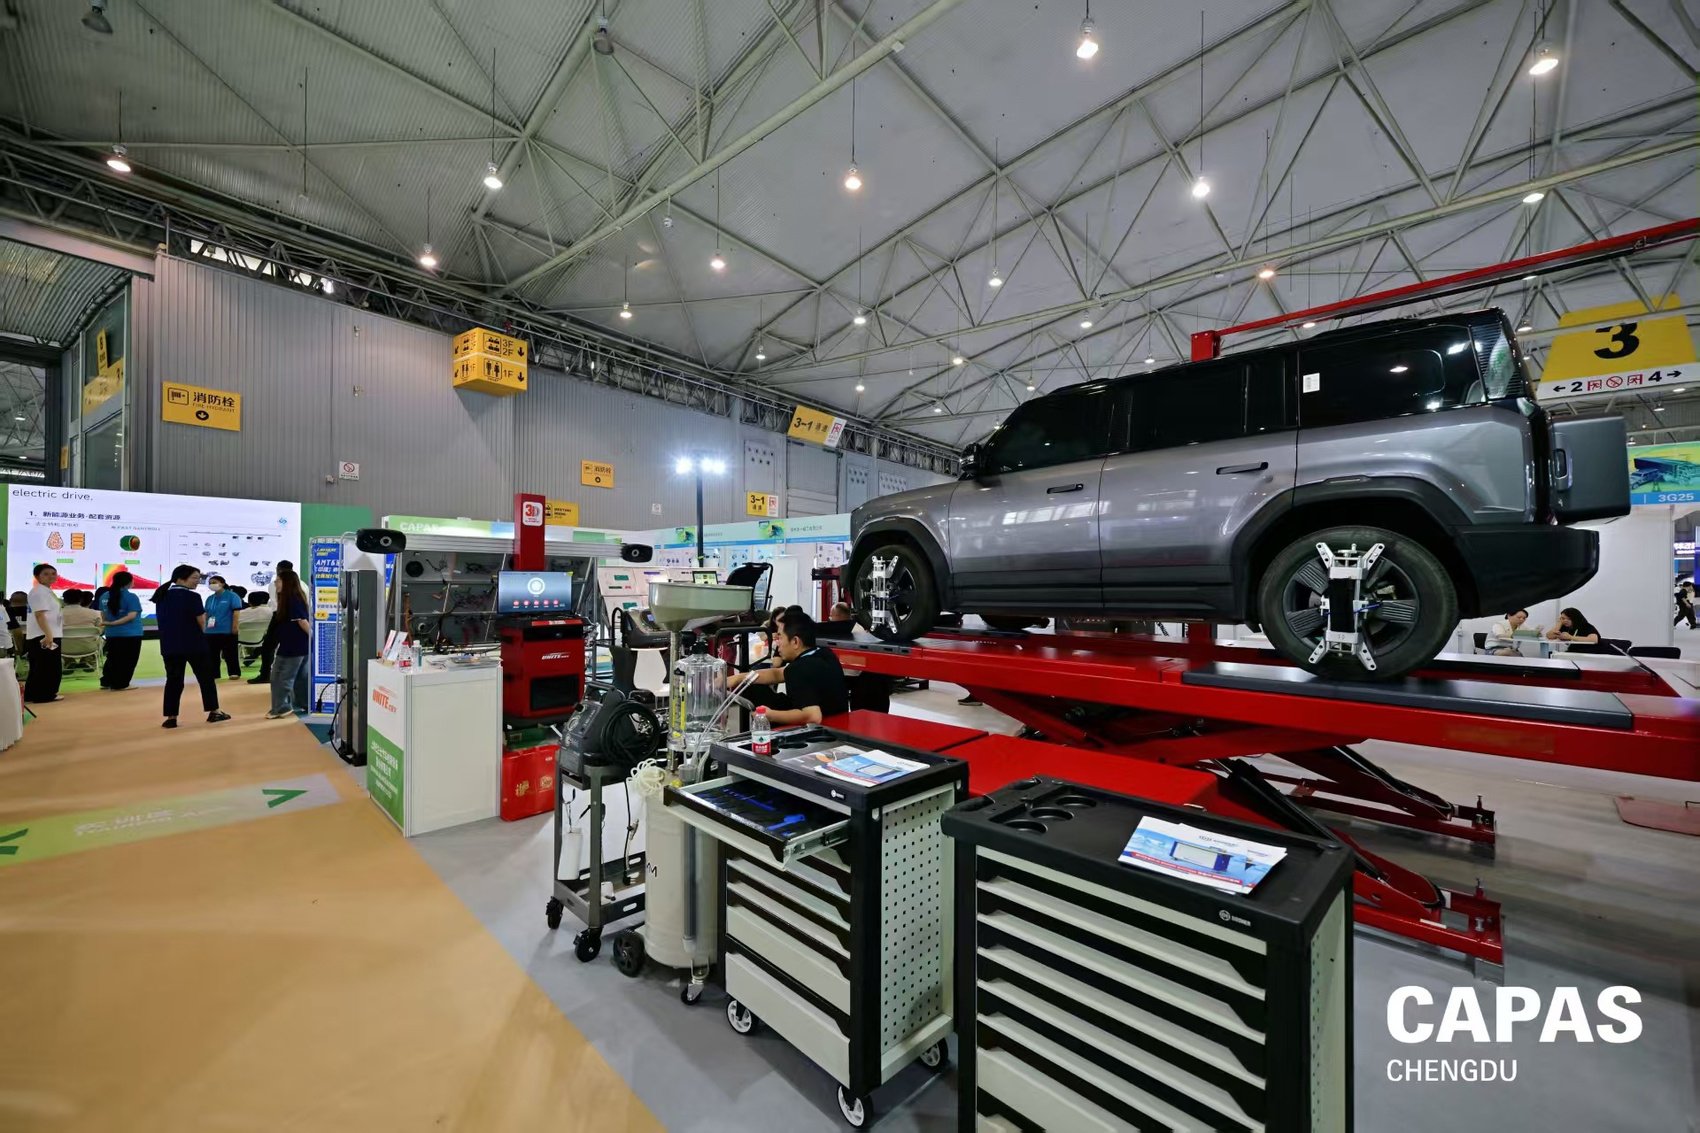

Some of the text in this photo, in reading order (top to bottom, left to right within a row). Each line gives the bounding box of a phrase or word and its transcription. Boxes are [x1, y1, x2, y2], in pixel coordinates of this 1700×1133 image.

[502, 339, 514, 348] 3F
[1593, 322, 1640, 359] 3
[502, 347, 514, 356] 2F
[503, 369, 514, 378] 1F
[1571, 371, 1662, 392] 2 4
[193, 391, 236, 408] 消防栓
[12, 488, 58, 499] electric
[1658, 493, 1694, 503] 3G25
[525, 504, 540, 517] 3D
